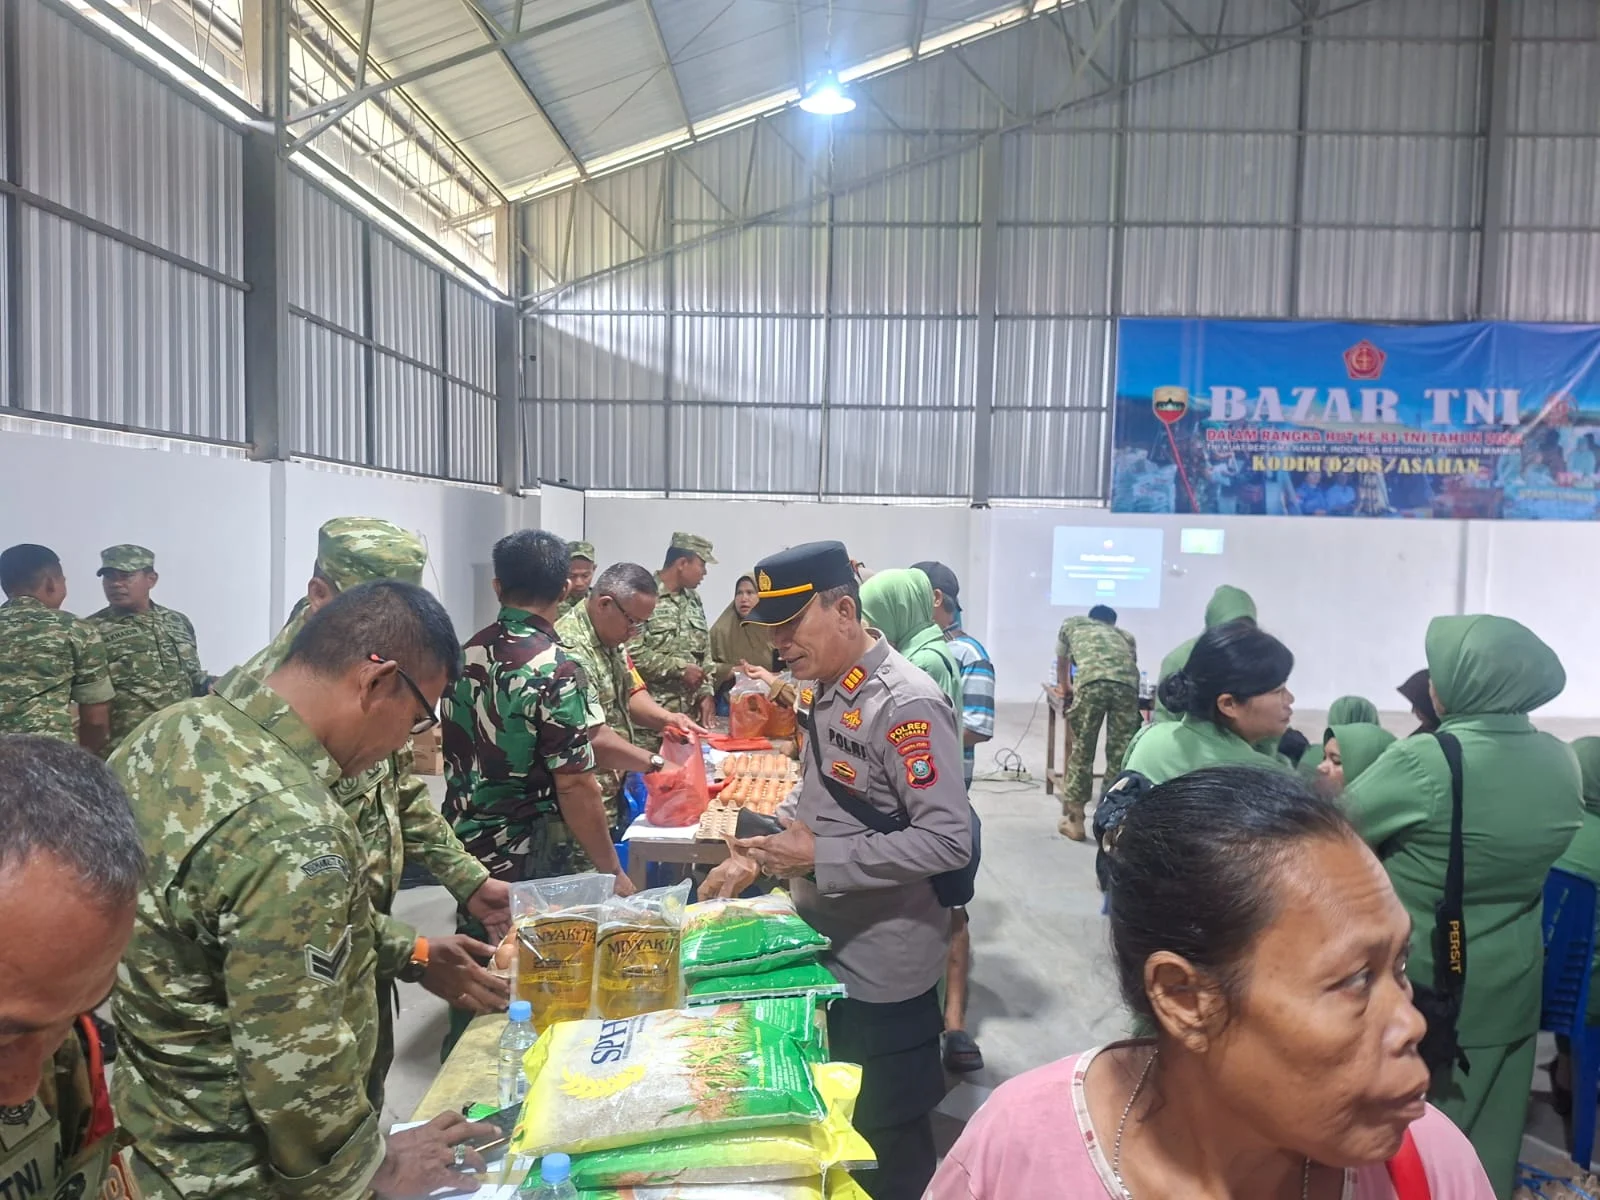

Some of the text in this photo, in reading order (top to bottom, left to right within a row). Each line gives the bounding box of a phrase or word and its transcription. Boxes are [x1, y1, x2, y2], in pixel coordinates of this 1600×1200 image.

[1208, 385, 1521, 426] BAZAR TNI
[1206, 428, 1258, 442] DALAM
[1261, 429, 1322, 443] RANGKA
[1326, 430, 1354, 443] HUT
[1357, 431, 1376, 444] KE
[1402, 432, 1426, 444] TNI
[1431, 432, 1482, 444] TAHUN
[1252, 455, 1322, 473] KODIM
[829, 728, 867, 759] POLRI
[890, 722, 928, 739] POLRES
[1449, 919, 1462, 974] PERSIT
[590, 1018, 630, 1065] SPH
[0, 1157, 43, 1200] TNI
